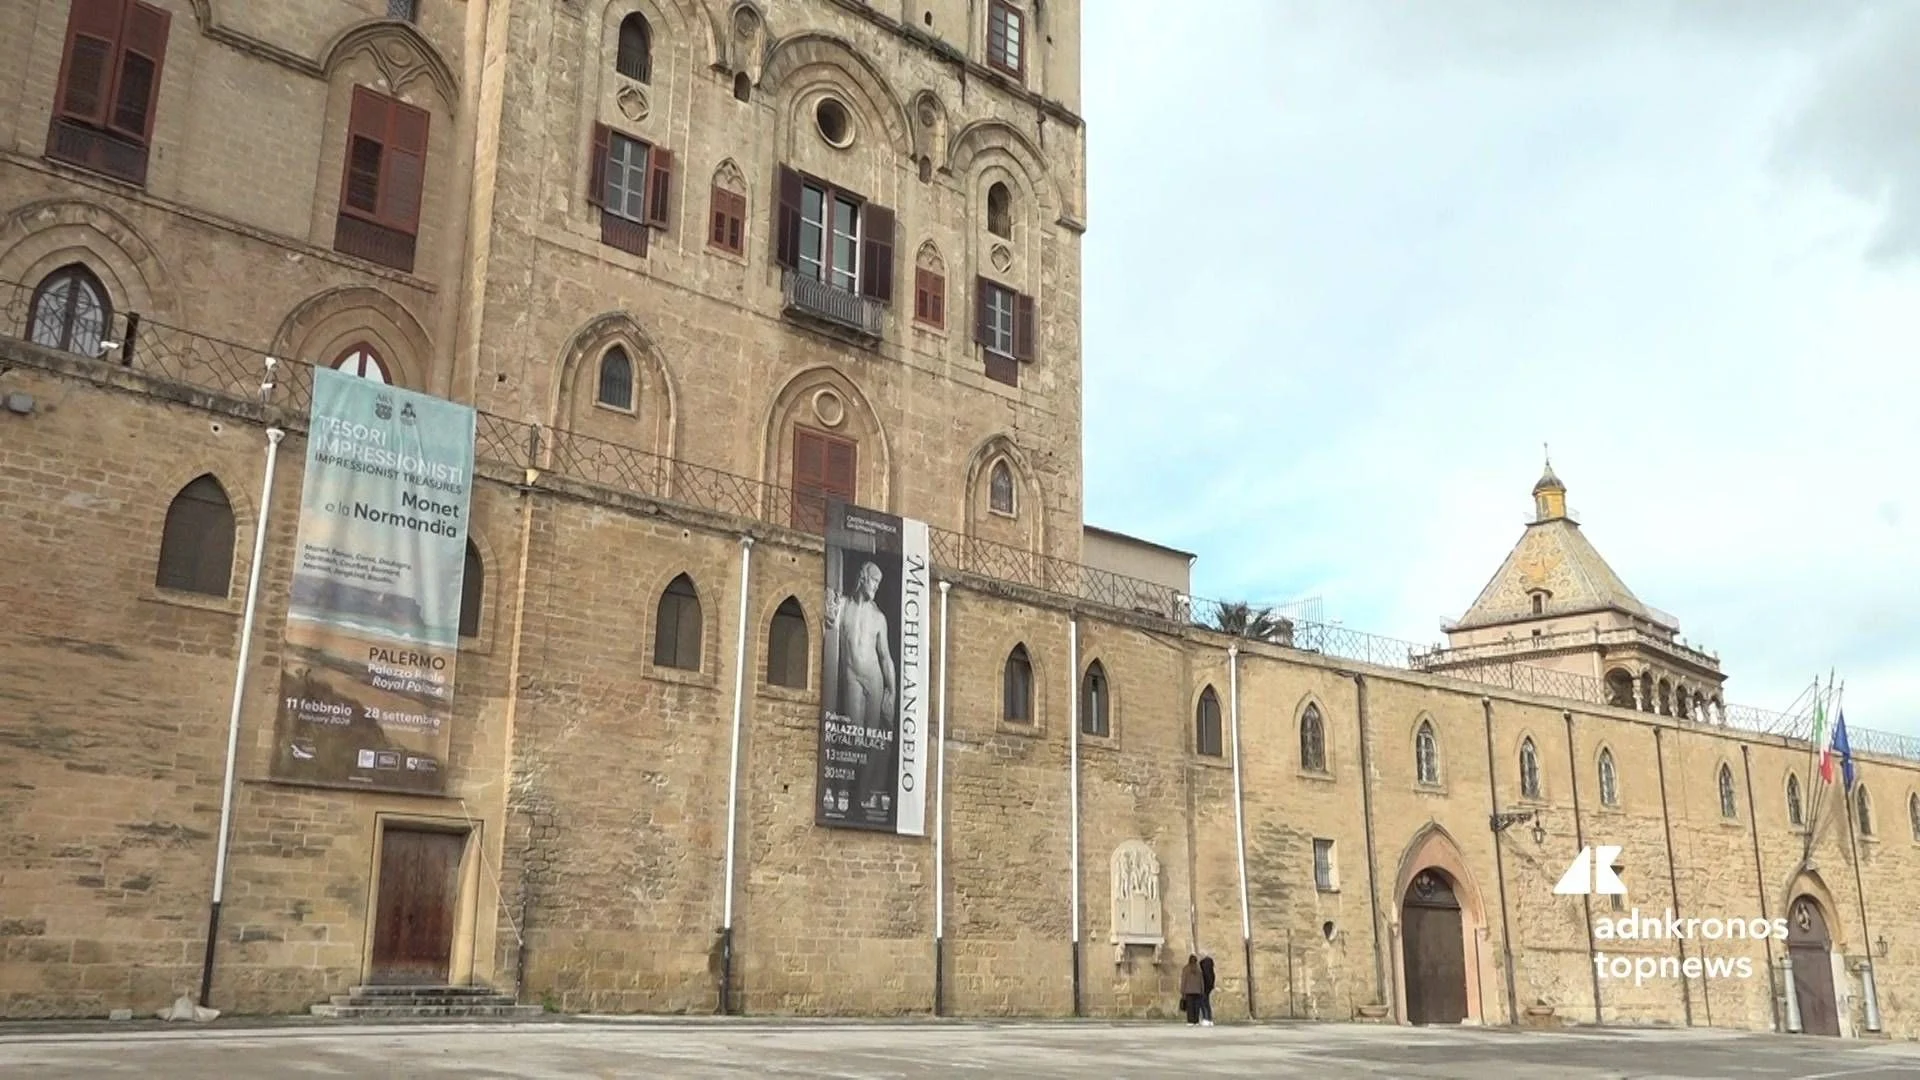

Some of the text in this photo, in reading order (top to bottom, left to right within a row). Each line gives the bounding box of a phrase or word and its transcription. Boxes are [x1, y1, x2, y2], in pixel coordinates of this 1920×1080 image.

[319, 416, 386, 446] TESORI
[316, 436, 463, 482] IMPRESSIONISTI
[315, 452, 462, 495] IMPRESSIONIST TREASURES
[401, 491, 459, 518] Monet
[338, 503, 350, 516] la
[354, 502, 457, 538] Normandia
[369, 647, 445, 670] PALERMO
[368, 663, 413, 678] Palazzo
[902, 554, 926, 793] MICHELANGELO
[372, 675, 444, 696] Royal Palace
[286, 697, 352, 716] 11 febbraio
[364, 706, 441, 727] 28 settembre
[825, 721, 893, 741] PALAZZO REALE
[825, 732, 885, 750] ROYAL PALACE
[825, 749, 836, 760] 13
